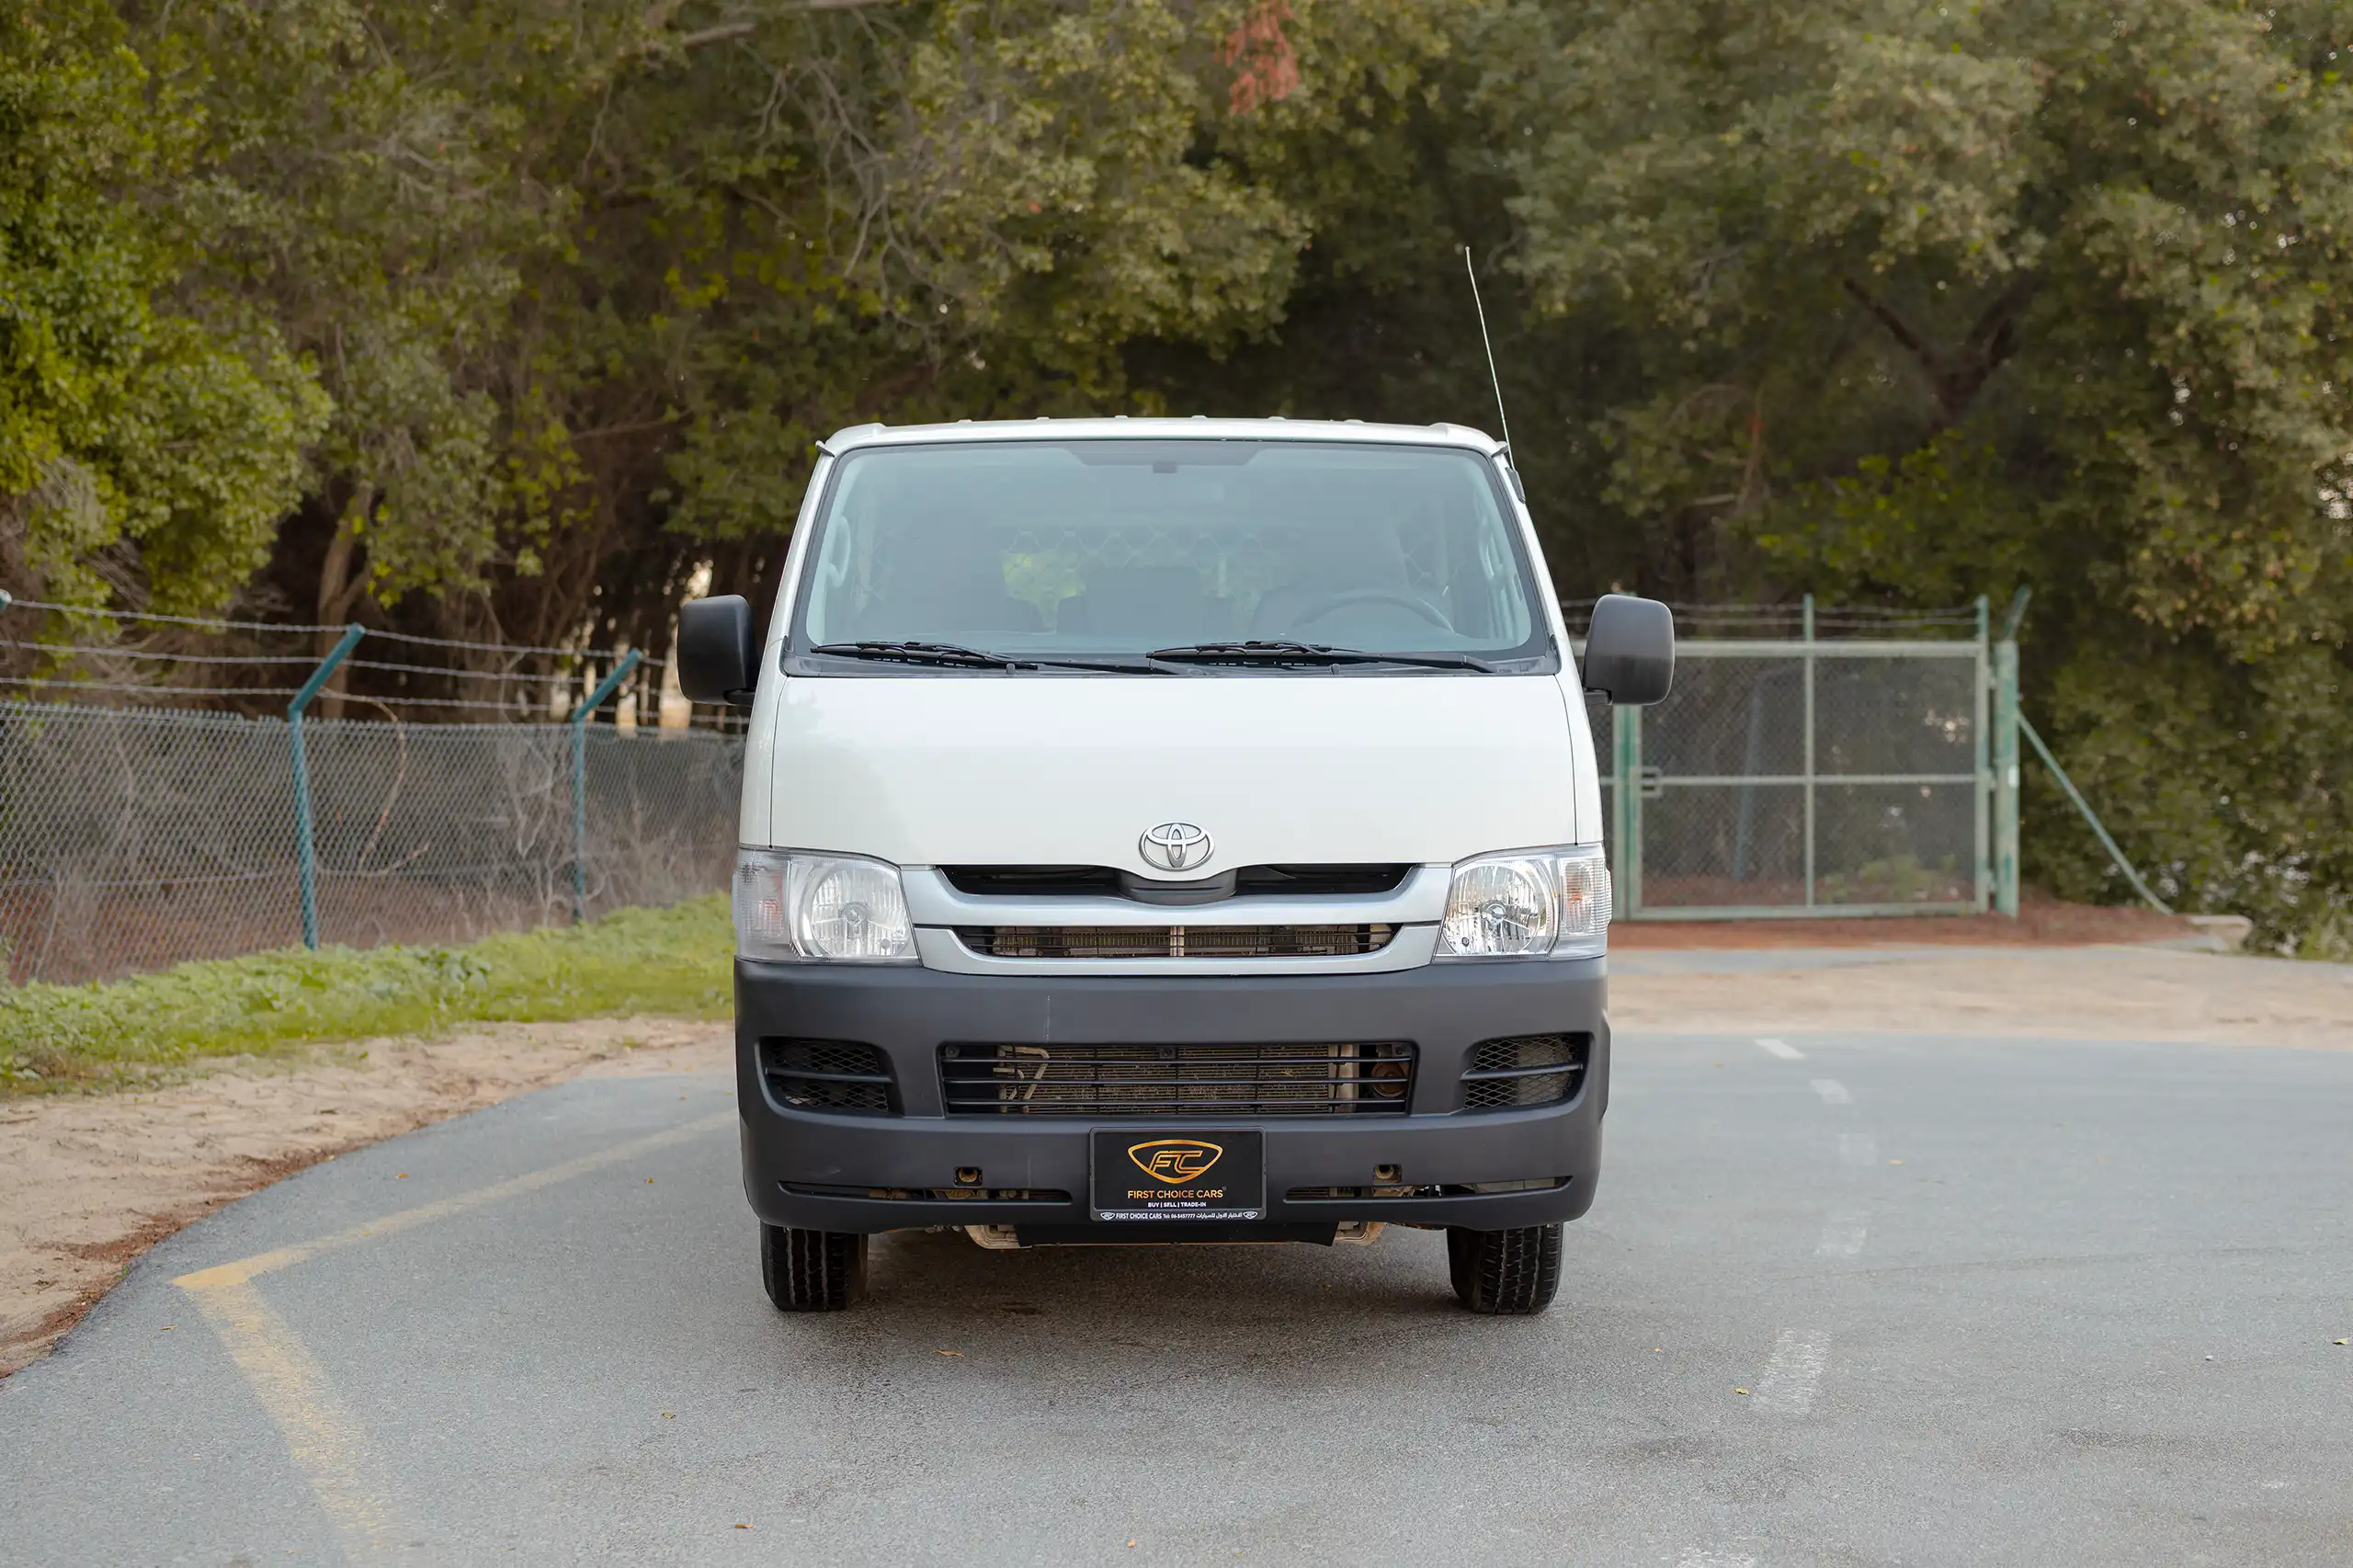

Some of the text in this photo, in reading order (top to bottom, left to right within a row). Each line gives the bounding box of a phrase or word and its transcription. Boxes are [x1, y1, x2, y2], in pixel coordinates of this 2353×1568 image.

[1128, 1189, 1223, 1199] FIRST CHOICE CARS
